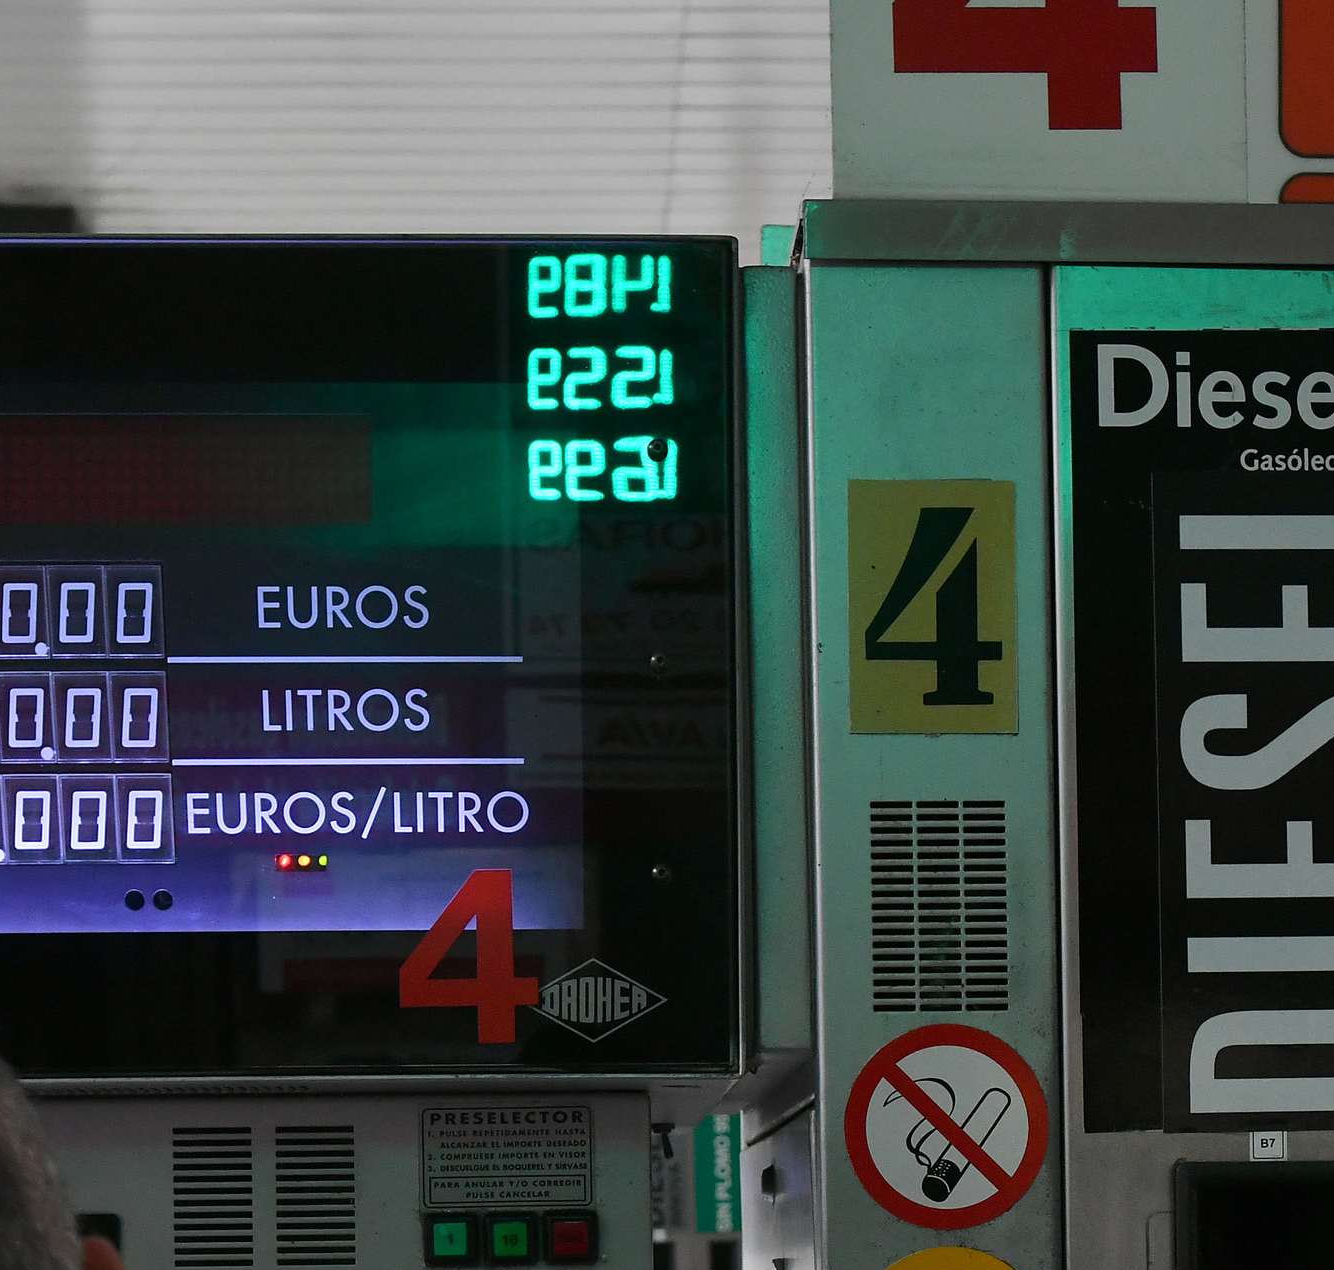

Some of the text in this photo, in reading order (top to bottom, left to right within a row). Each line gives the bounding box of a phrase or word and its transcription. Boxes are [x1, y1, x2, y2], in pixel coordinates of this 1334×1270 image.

[255, 584, 431, 631] EUROS
[865, 507, 1004, 706] 4
[260, 688, 431, 734] LITROS
[185, 787, 531, 840] EUROS/LITRO
[398, 868, 540, 1044] 4
[429, 1110, 585, 1127] PRESELECTOR
[1259, 1137, 1276, 1150] B7
[433, 1181, 460, 1189] PARA
[499, 1190, 551, 1199] CANCELAR
